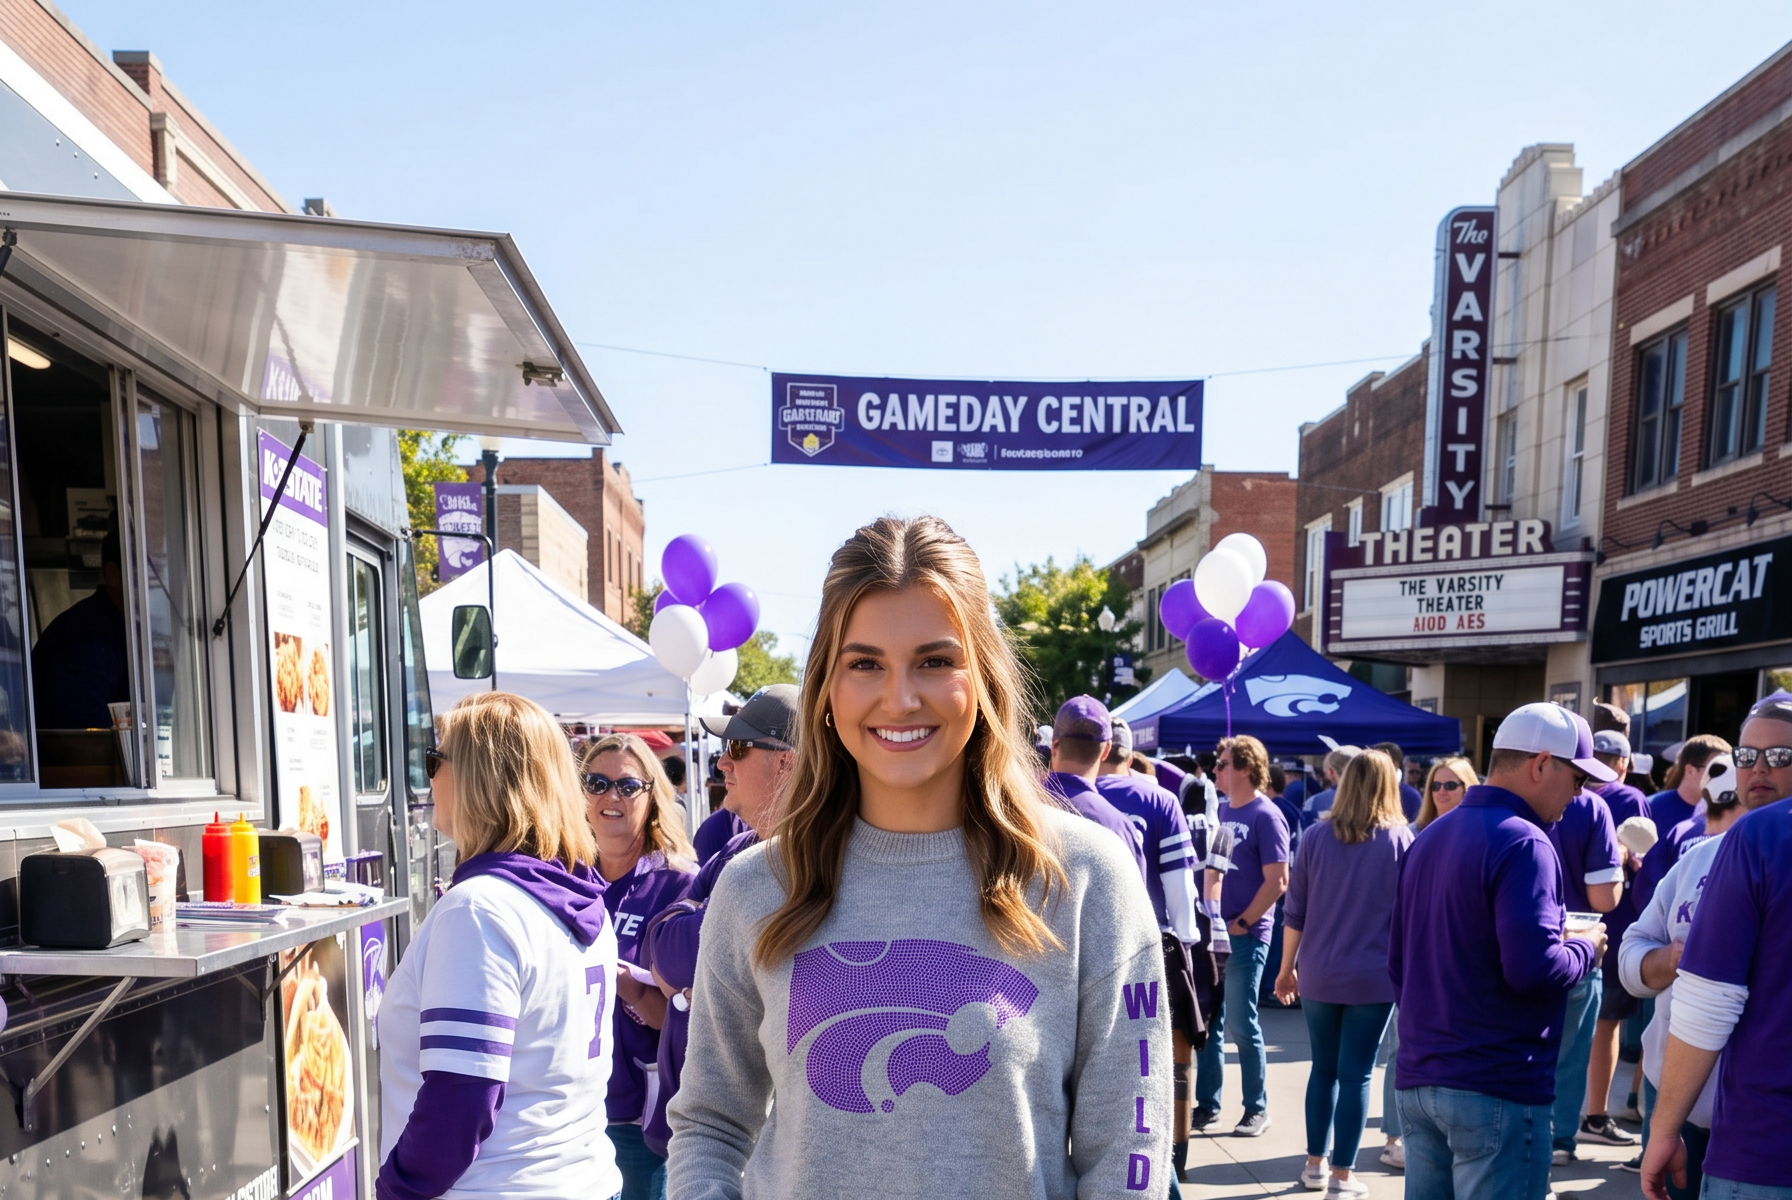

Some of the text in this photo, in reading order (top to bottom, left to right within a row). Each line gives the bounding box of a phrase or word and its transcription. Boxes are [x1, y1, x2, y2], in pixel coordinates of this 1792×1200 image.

[1453, 218, 1489, 244] The
[1444, 252, 1486, 510] VARSITY
[857, 392, 1195, 434] GAMEDAY CENTRAL
[1359, 519, 1546, 566] THEATER
[1399, 574, 1504, 597] THE VARSITY
[1417, 595, 1484, 613] THEATER
[1620, 552, 1774, 622] POWERCAT
[1456, 613, 1486, 631] AES
[1639, 611, 1739, 649] SPORTS GRILL
[585, 964, 607, 1060] 7
